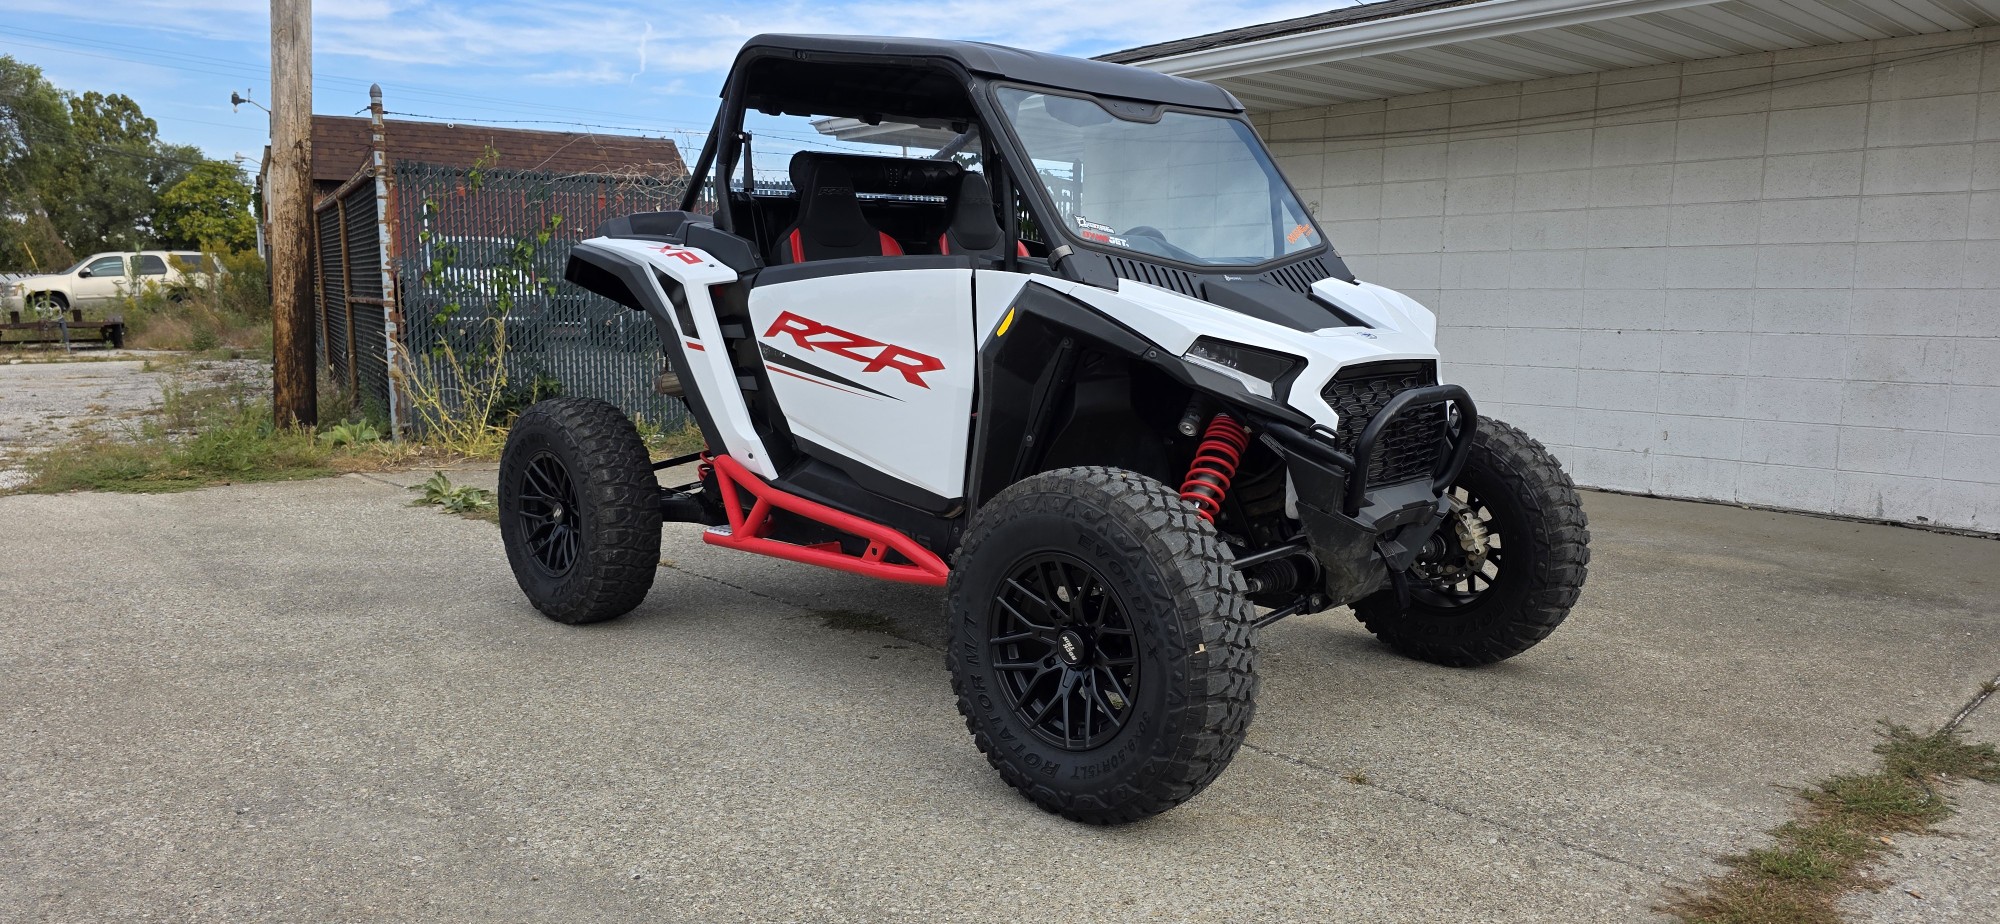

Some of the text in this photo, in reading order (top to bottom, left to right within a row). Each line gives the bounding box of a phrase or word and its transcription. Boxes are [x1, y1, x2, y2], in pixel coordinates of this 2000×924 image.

[646, 245, 704, 264] XP
[763, 310, 946, 390] RZR
[963, 610, 1061, 779] ROTATOR M/T
